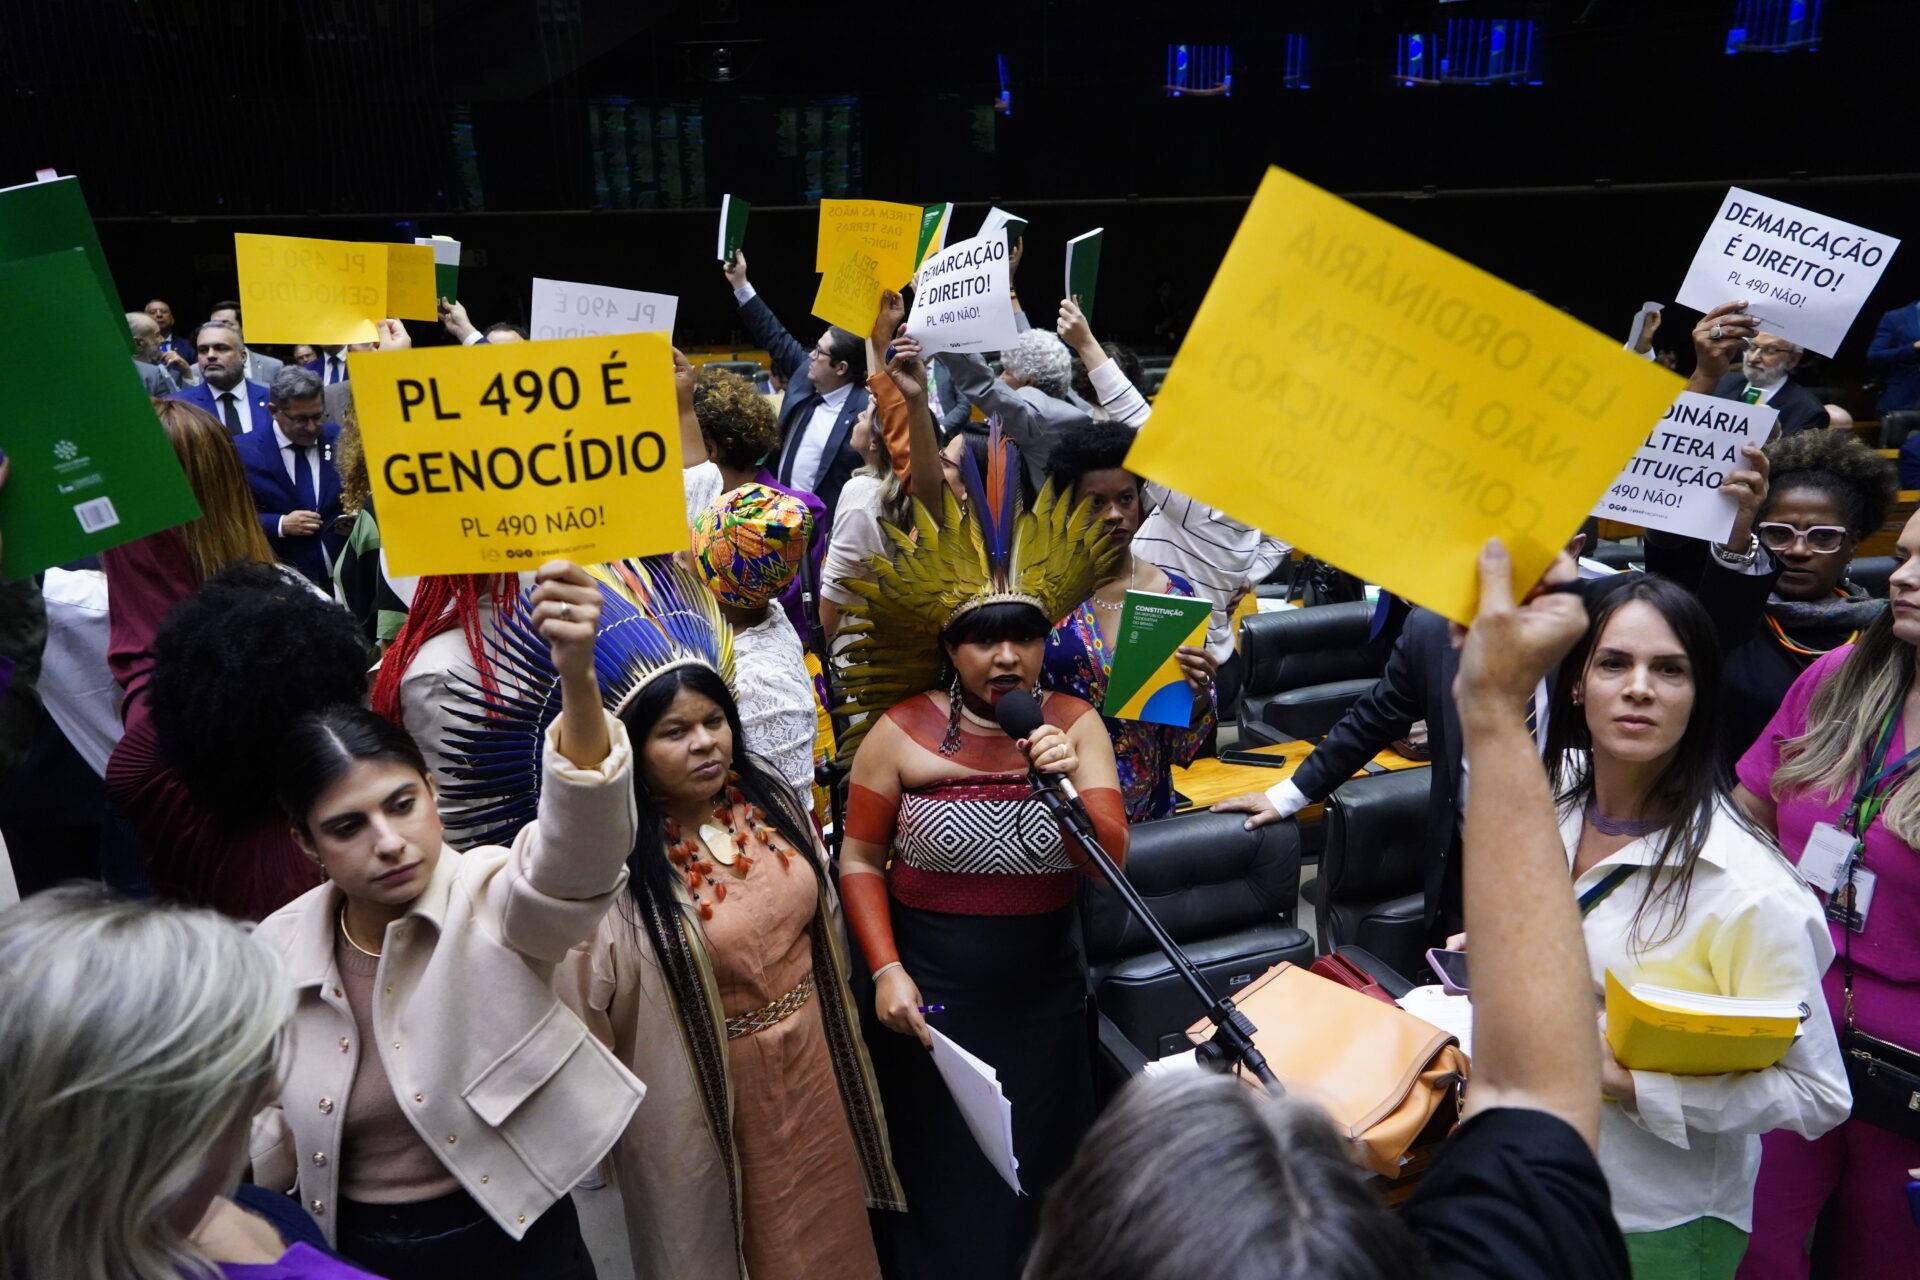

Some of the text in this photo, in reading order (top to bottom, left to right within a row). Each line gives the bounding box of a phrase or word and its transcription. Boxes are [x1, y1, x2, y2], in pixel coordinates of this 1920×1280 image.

[1724, 202, 1883, 267] DEMARCAÇÃO
[920, 241, 1004, 287] DEMARCAÇÃO
[1723, 234, 1845, 292] É DIREITO!
[929, 274, 991, 305] DIREITO!
[1727, 270, 1807, 308] PL 490 NÃO!
[926, 306, 981, 327] PL 490 NÃO!
[396, 351, 631, 422] PL 490 É
[383, 429, 667, 495] GENOCÍDIO
[1644, 430, 1736, 463] LTERA A
[1623, 456, 1724, 489] ITUIÇÃO
[1610, 484, 1683, 508] 490 NÃO!
[460, 505, 605, 538] PL 490 NÃO!
[1135, 605, 1184, 617] CONSTITUIÇÃO
